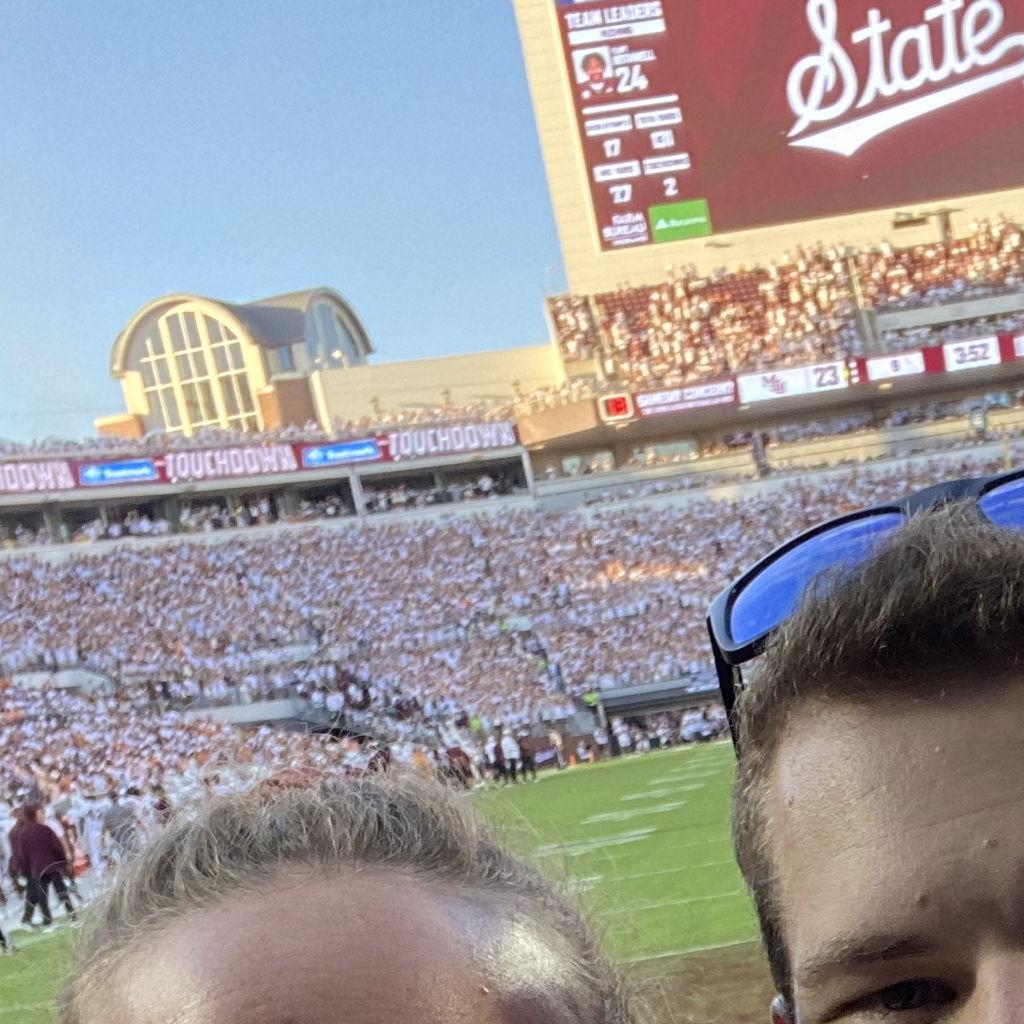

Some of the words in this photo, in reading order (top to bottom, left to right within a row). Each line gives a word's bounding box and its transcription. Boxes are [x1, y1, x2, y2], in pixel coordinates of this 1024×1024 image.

[615, 64, 649, 93] 24
[813, 366, 840, 387] 23
[388, 422, 516, 456] TOUCHDOWN
[165, 444, 298, 478] TOUCHDOWN
